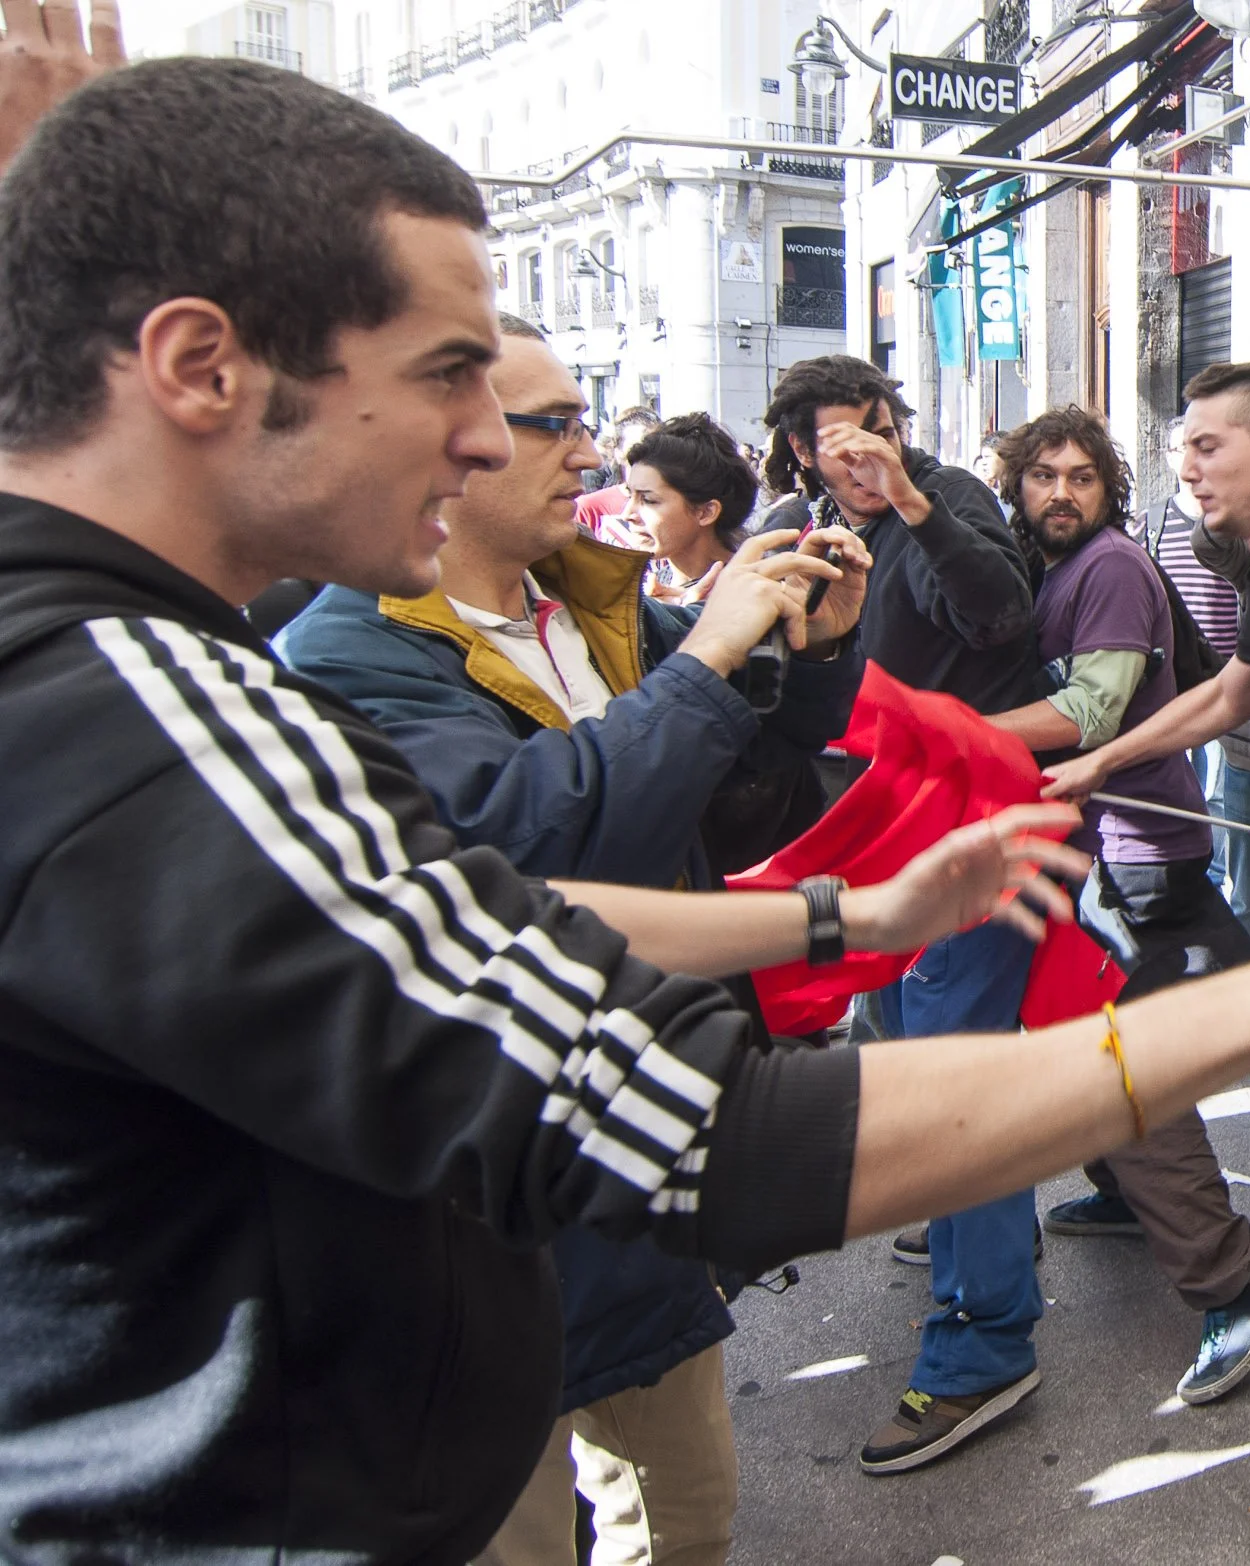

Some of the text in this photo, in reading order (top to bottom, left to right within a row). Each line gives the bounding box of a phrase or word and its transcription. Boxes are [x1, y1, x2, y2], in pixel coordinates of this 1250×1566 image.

[895, 68, 1016, 114] CHANGE
[727, 272, 758, 281] CARMEN
[978, 199, 1014, 345] ANGE
